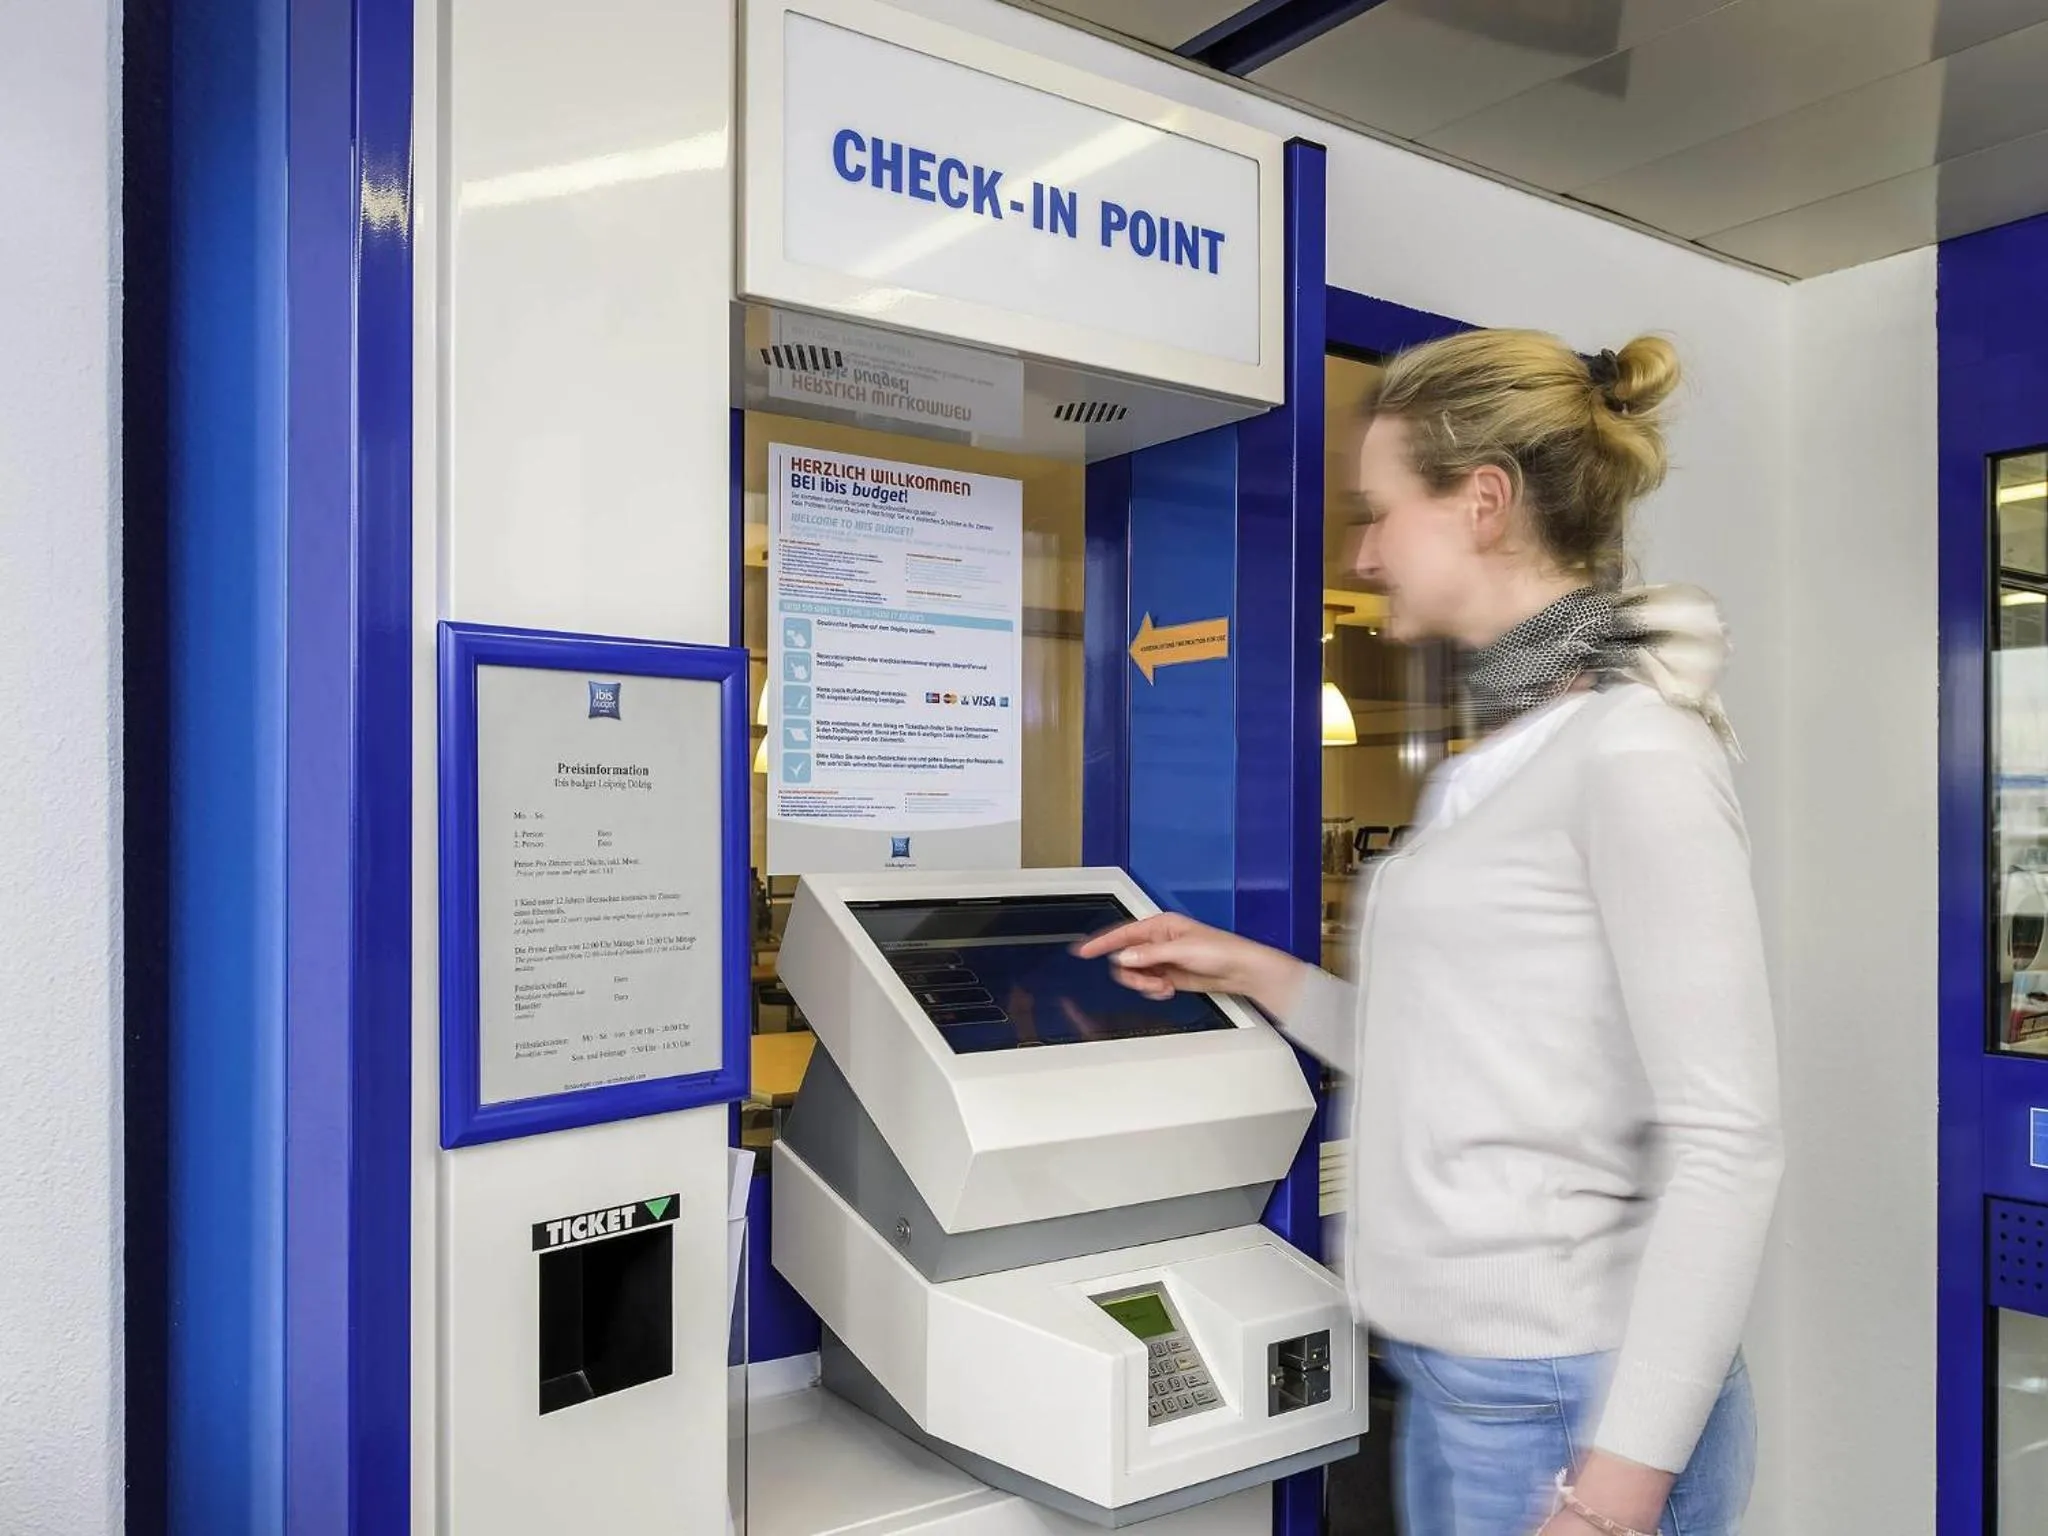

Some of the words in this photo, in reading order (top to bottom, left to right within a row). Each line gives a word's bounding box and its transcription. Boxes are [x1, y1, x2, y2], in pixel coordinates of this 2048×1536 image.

[833, 128, 1078, 239] CHECK-IN
[1101, 200, 1226, 276] POINT
[791, 456, 866, 482] HERZLICH
[870, 467, 972, 497] WILLKOMMEN
[791, 473, 816, 491] BEI
[820, 476, 848, 496] ibis
[852, 481, 909, 504] budget!
[791, 513, 839, 528] WELCOME
[841, 518, 853, 529] TO
[596, 689, 614, 701] ibis
[972, 695, 996, 707] VISA
[557, 762, 650, 776] Preisinformation
[546, 1205, 636, 1246] TICKET
